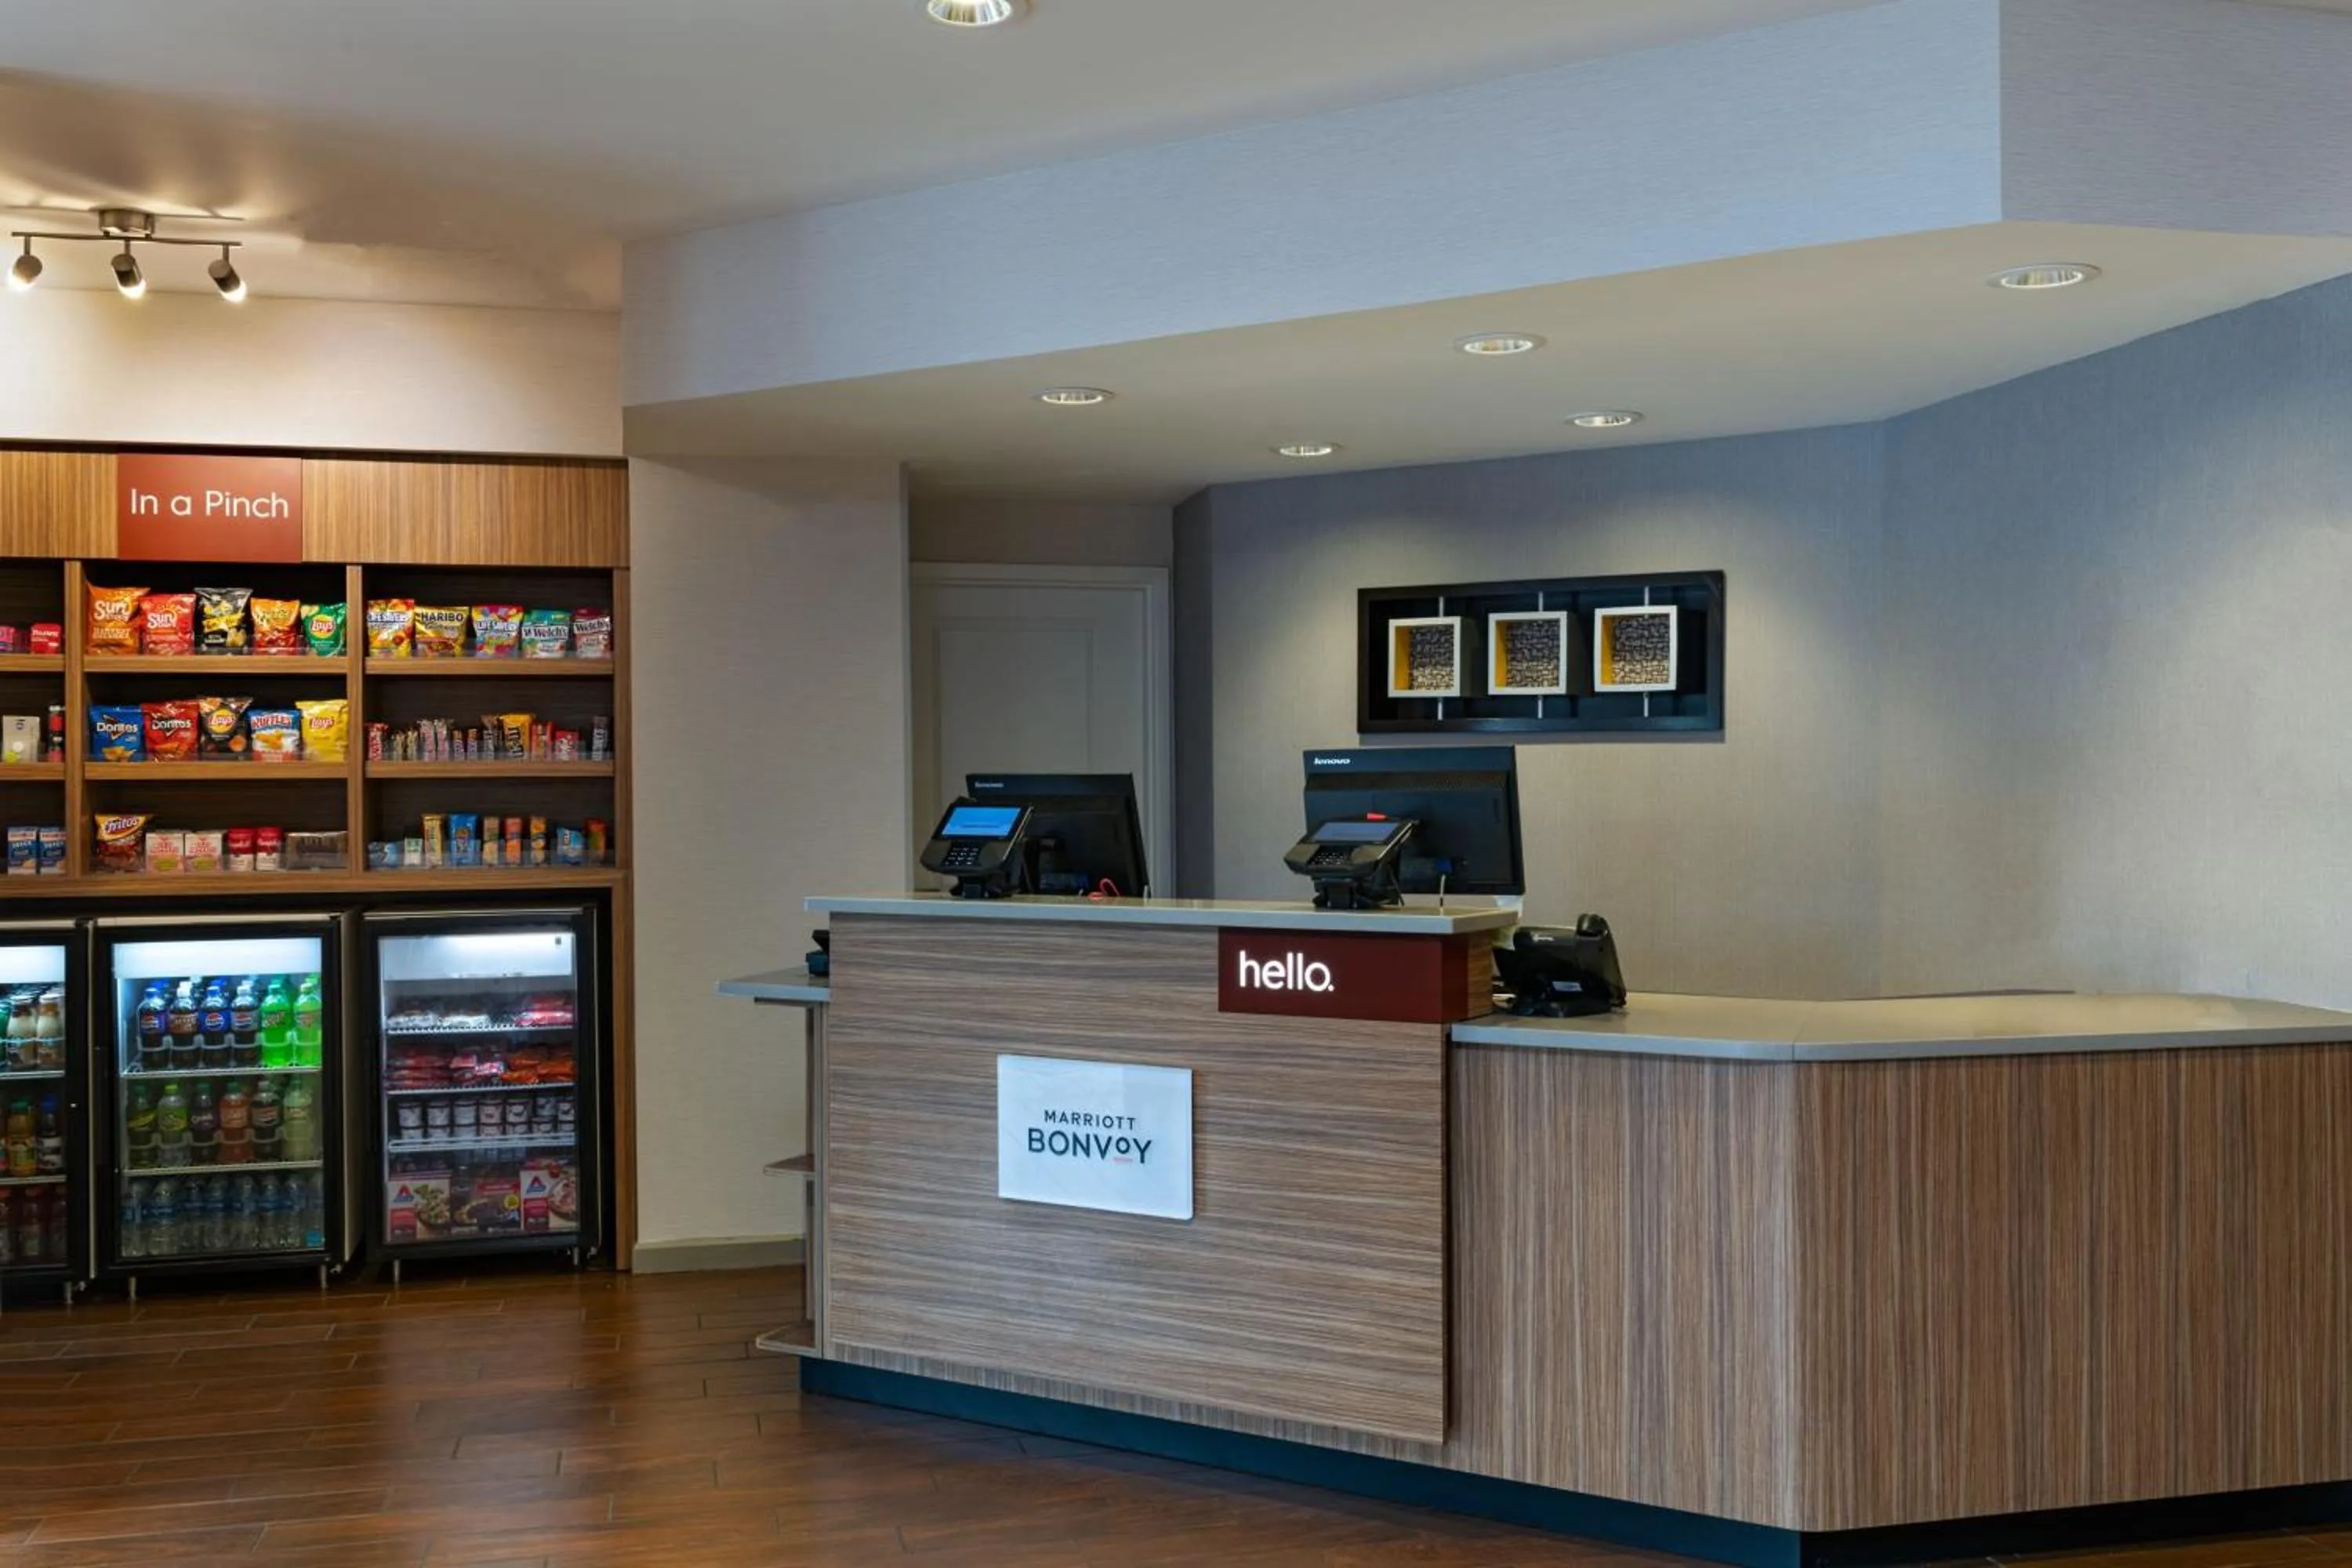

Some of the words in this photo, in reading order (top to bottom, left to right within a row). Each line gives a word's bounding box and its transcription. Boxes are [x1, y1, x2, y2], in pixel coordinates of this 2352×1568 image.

[130, 488, 158, 515] In
[169, 495, 192, 517] a
[205, 489, 289, 518] Pinch
[421, 612, 463, 622] HARIBO
[96, 722, 139, 732] Doritos
[151, 719, 192, 730] Doritos
[1239, 949, 1334, 992] hello.
[1044, 1109, 1137, 1131] MARRIOTT
[1027, 1127, 1152, 1164] BONVOY
